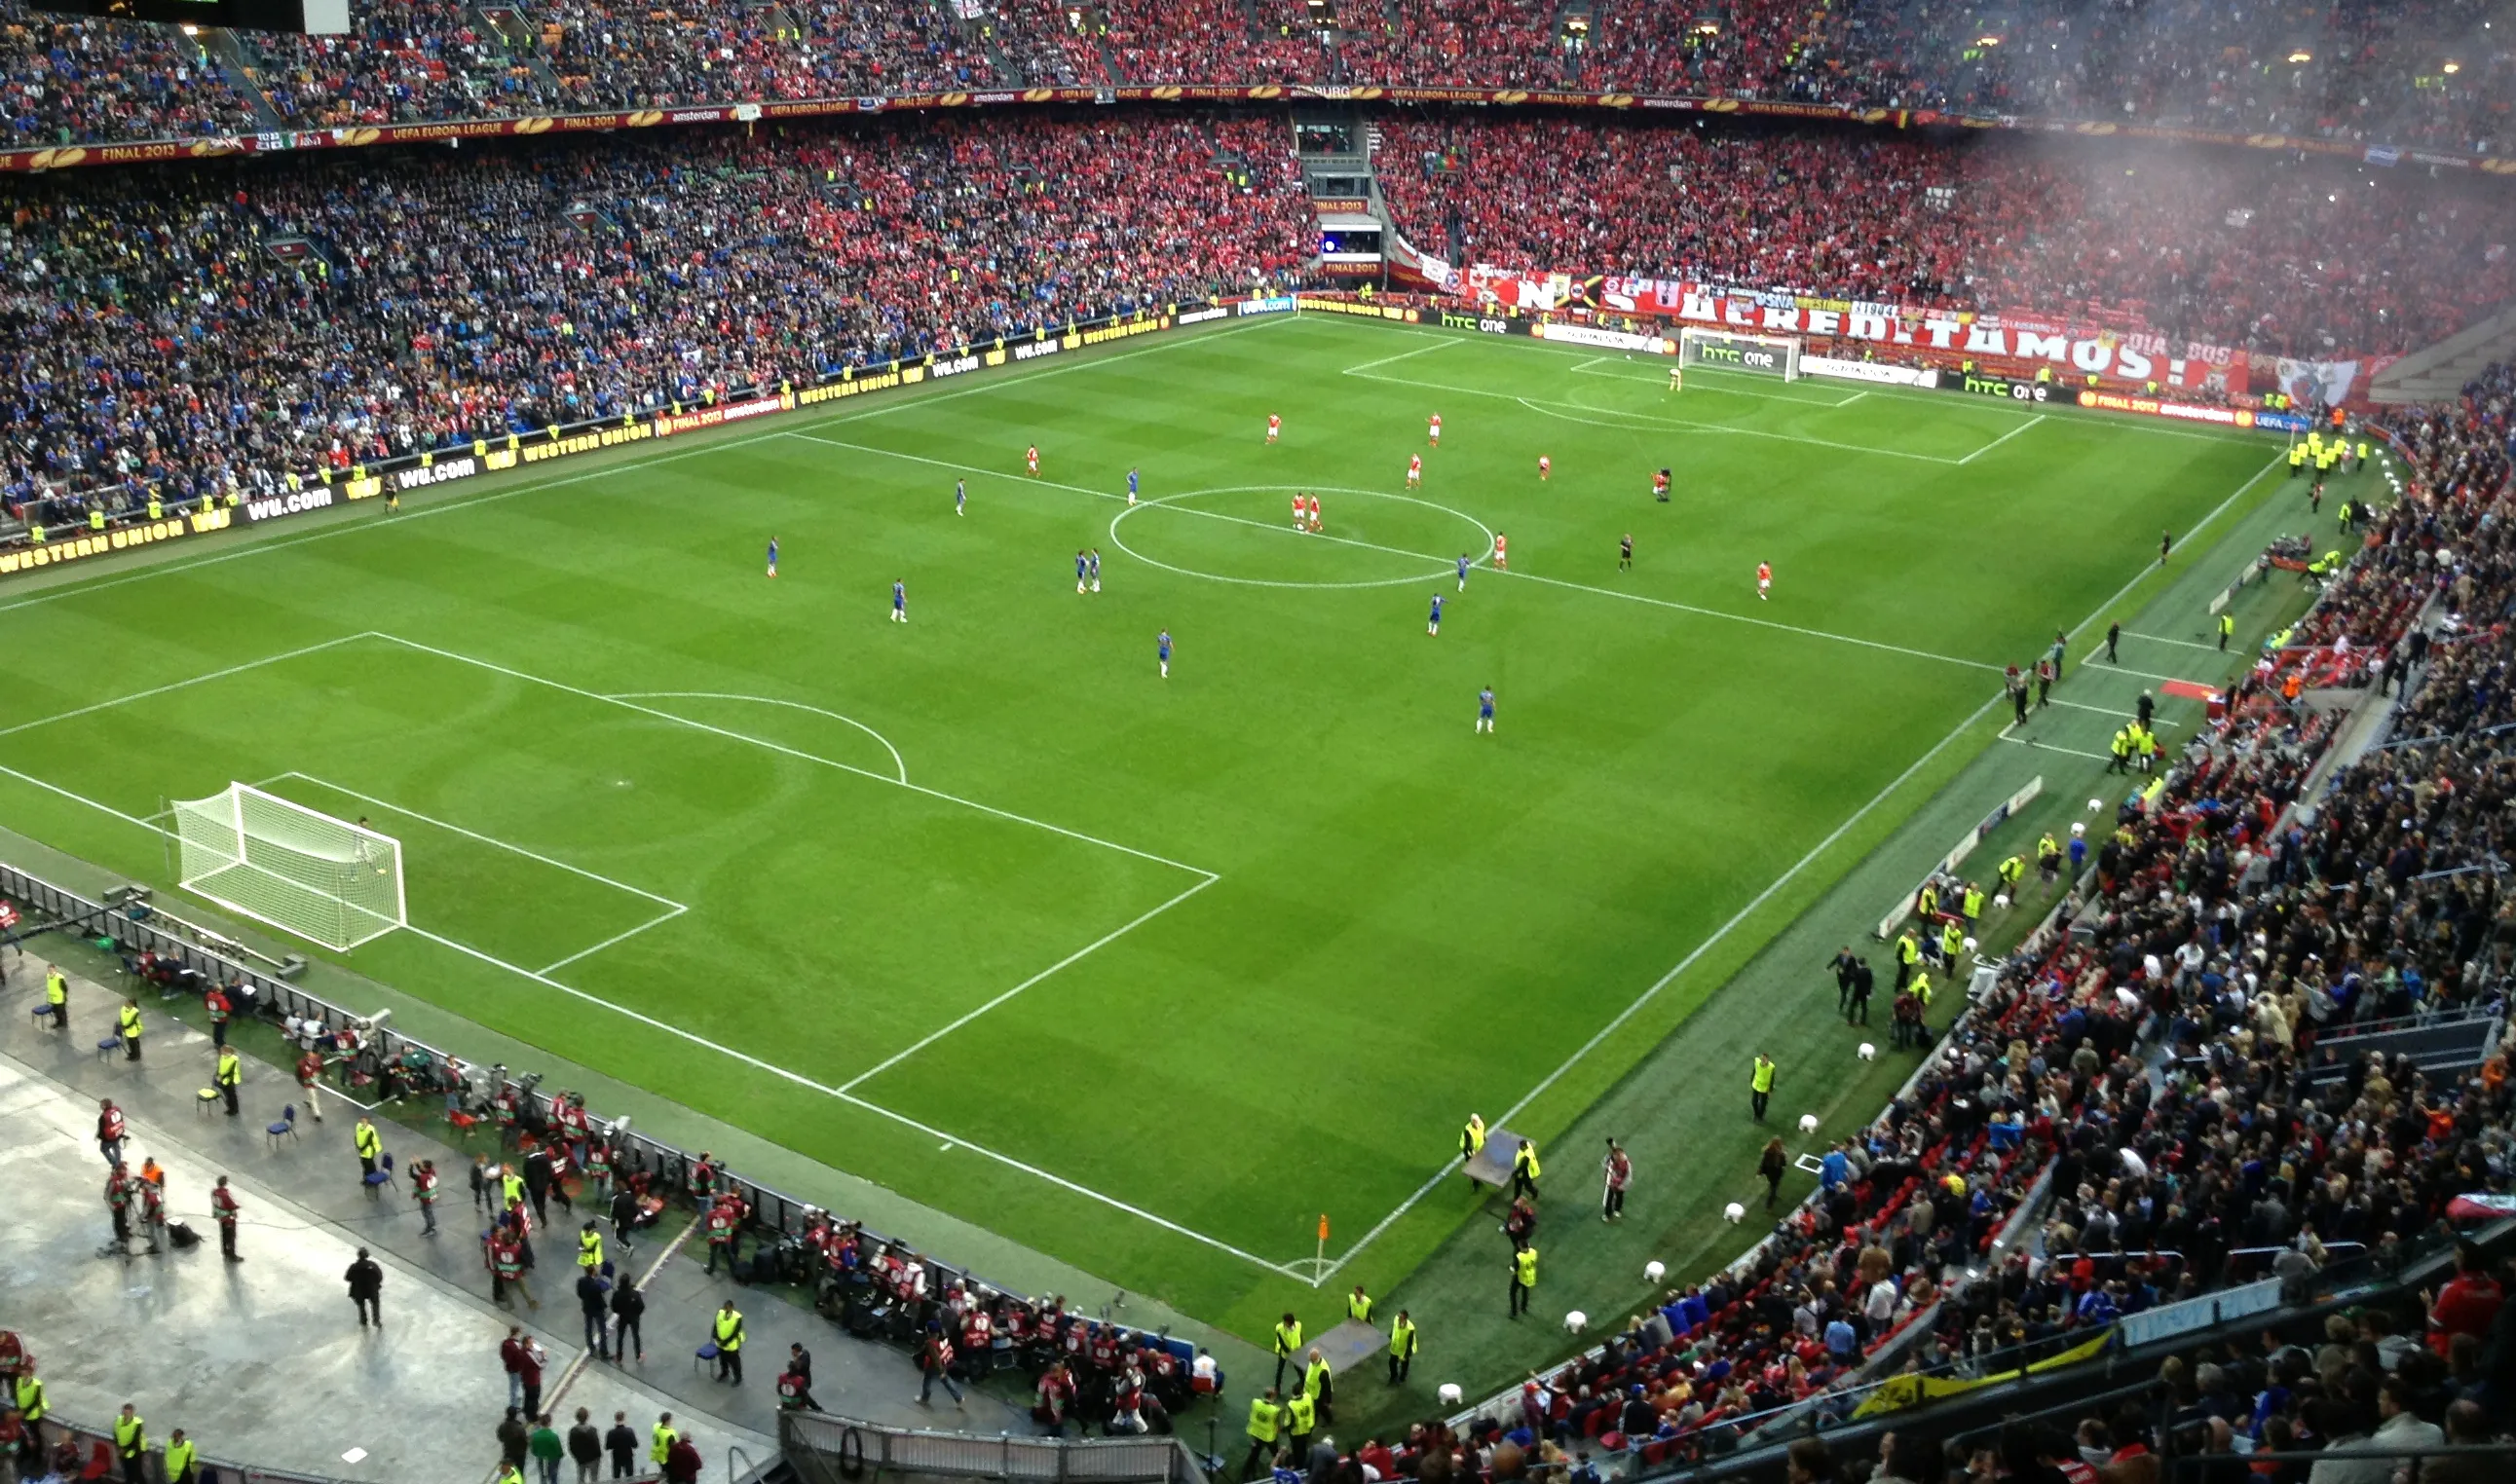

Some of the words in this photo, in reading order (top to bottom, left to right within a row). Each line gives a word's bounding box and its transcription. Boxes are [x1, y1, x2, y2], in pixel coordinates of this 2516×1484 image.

[1117, 88, 1142, 98] EAGUE
[564, 116, 591, 129] FINAL
[593, 114, 617, 127] 2013
[672, 109, 720, 124] amsterdam
[393, 127, 420, 141] UEFA
[422, 125, 461, 139] EUROPA
[464, 122, 502, 135] LEAGUE
[101, 147, 142, 161] FINAL
[145, 144, 176, 159] 2013
[1340, 201, 1363, 211] 2013
[1326, 263, 1353, 274] FINAL
[1443, 313, 1477, 330] htc
[1480, 316, 1507, 334] one
[1702, 343, 1741, 363] htc
[1744, 351, 1774, 368] one
[932, 355, 979, 378] wu.com
[799, 381, 859, 405] WESTERN
[859, 372, 899, 392] UNION
[1965, 376, 2009, 397] htc
[673, 414, 700, 430] FINAL
[700, 409, 723, 426] 2013
[2159, 402, 2234, 424] amsterdam
[523, 433, 600, 463] WESTERN
[601, 423, 652, 447] UNION
[398, 458, 475, 489] wu.com
[246, 487, 332, 521] wu.com
[0, 536, 109, 574] WESTERN
[111, 519, 185, 549] UNION
